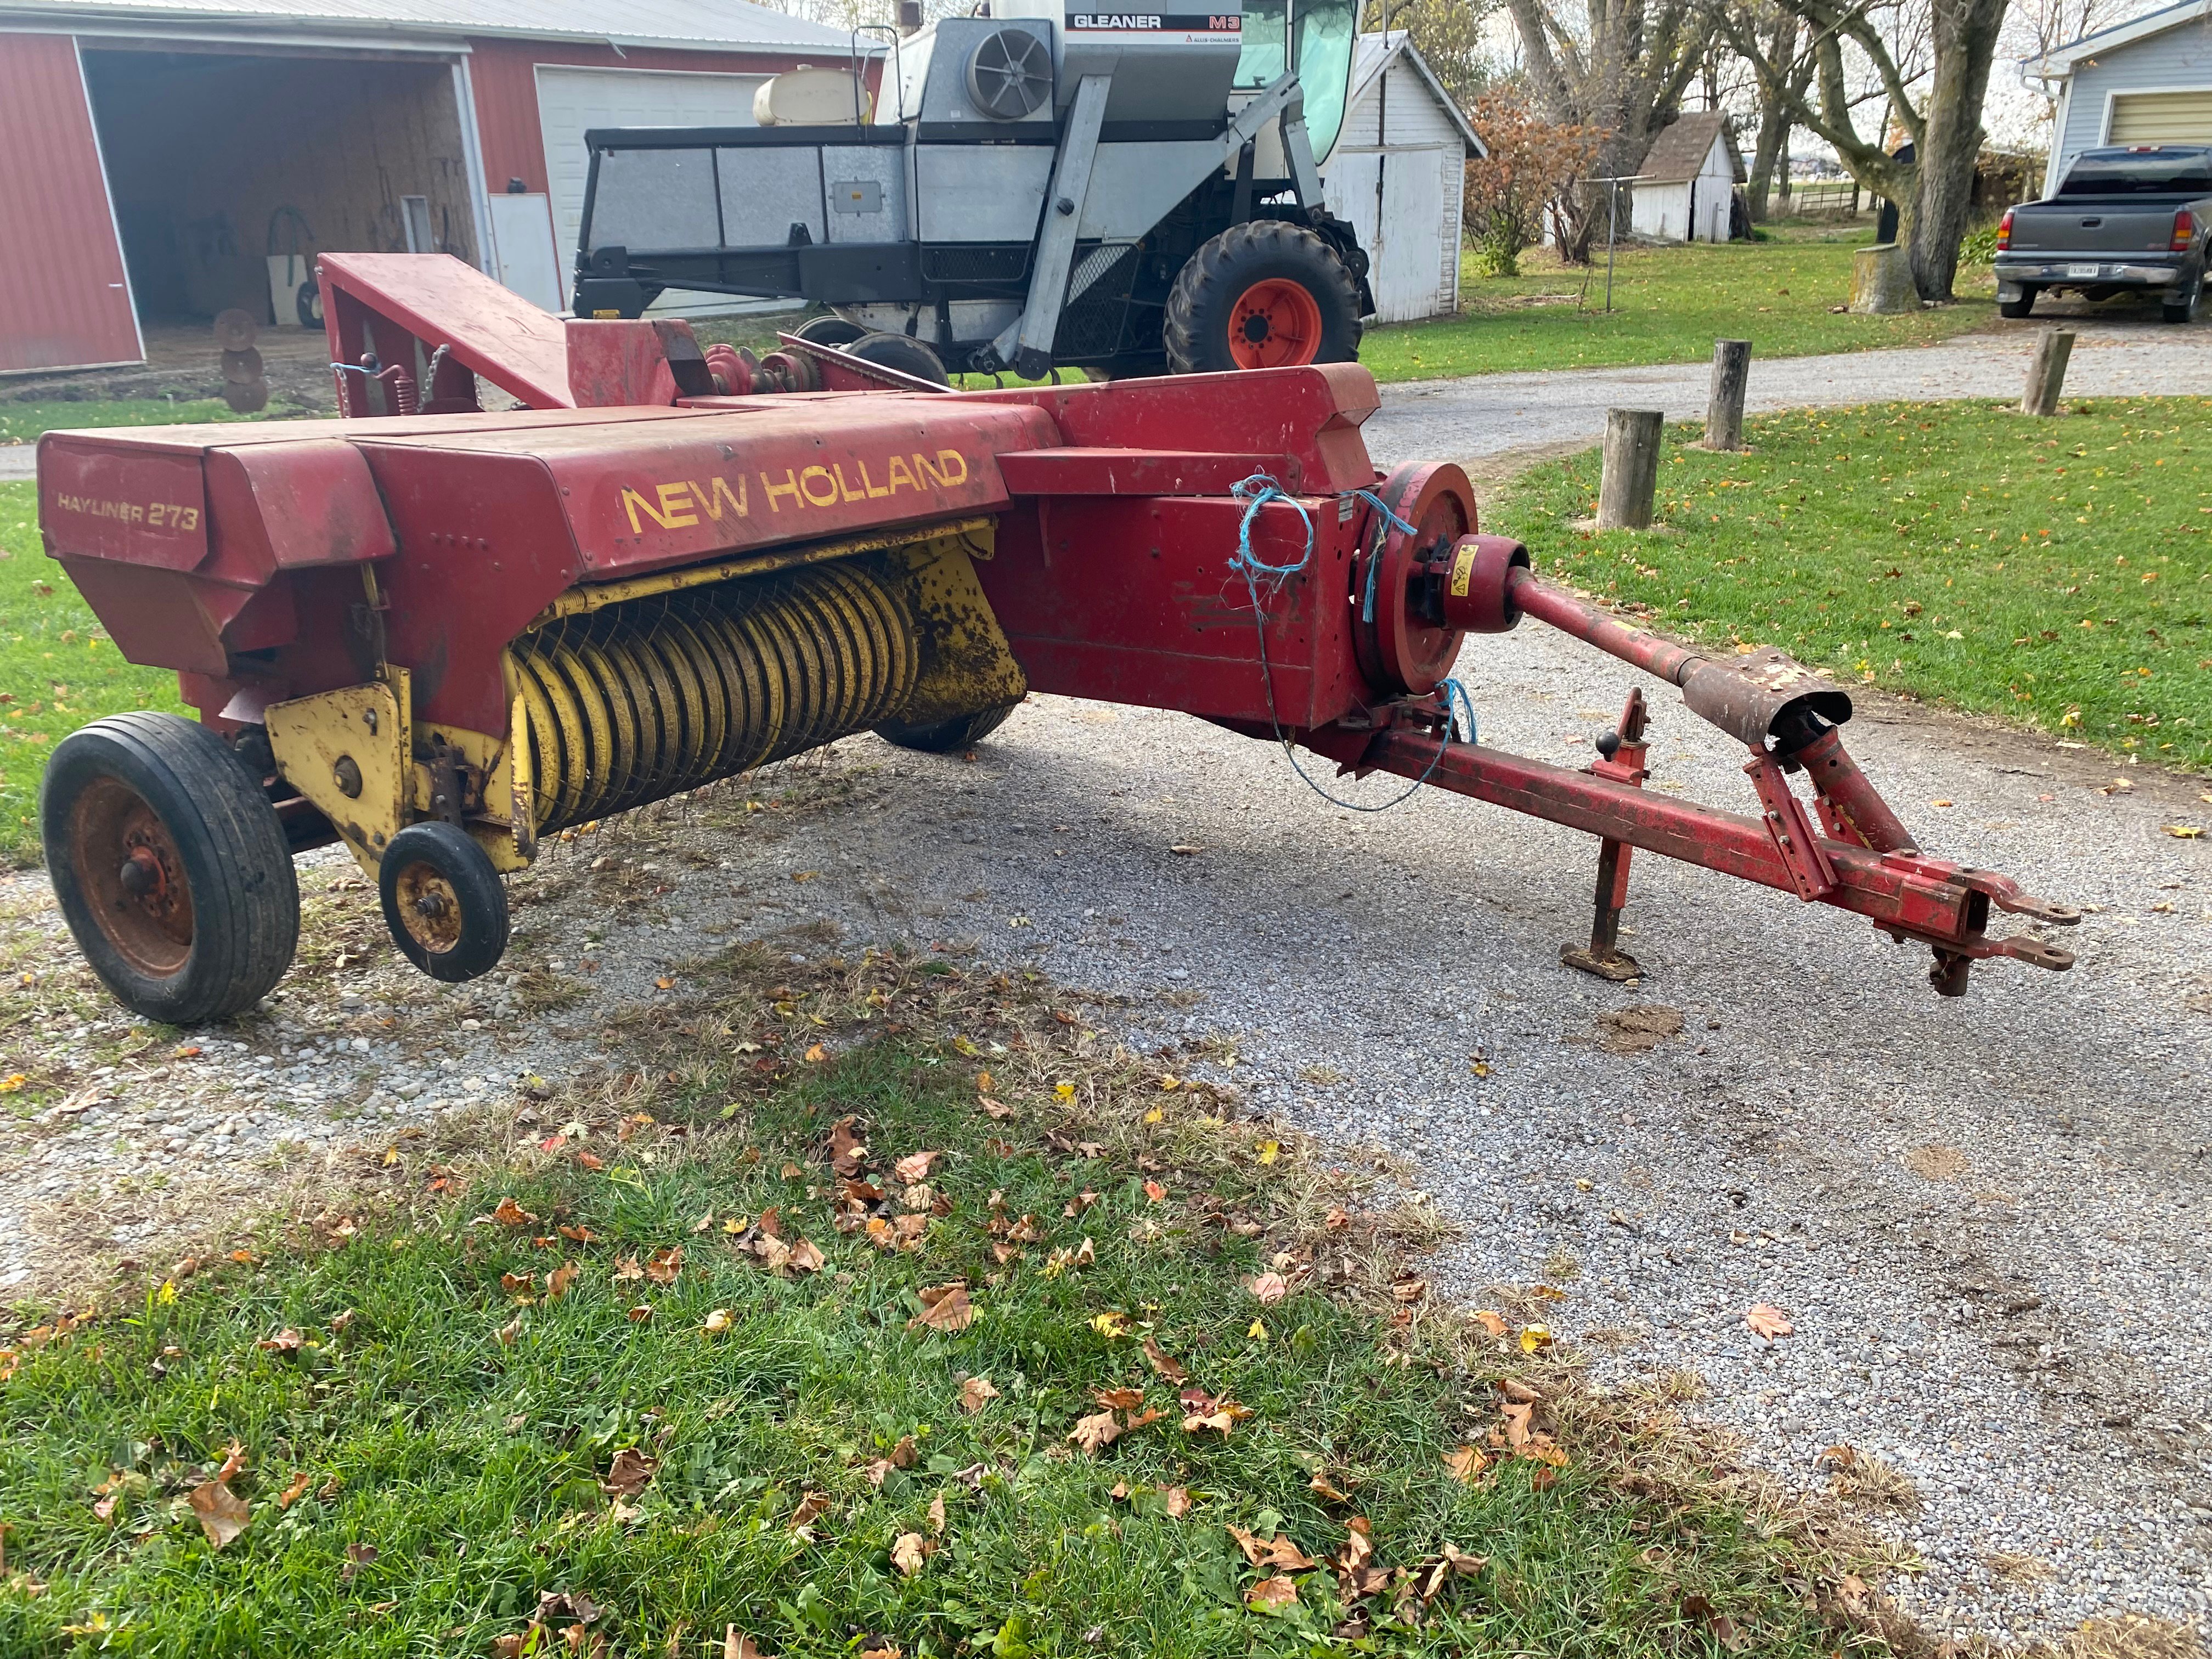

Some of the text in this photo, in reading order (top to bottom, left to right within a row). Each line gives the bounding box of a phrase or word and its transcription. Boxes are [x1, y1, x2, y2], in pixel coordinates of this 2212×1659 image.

[1074, 14, 1240, 29] GLEANER M3
[620, 449, 968, 534] NEW HOLLAND
[57, 492, 199, 531] HAYLINER 273
